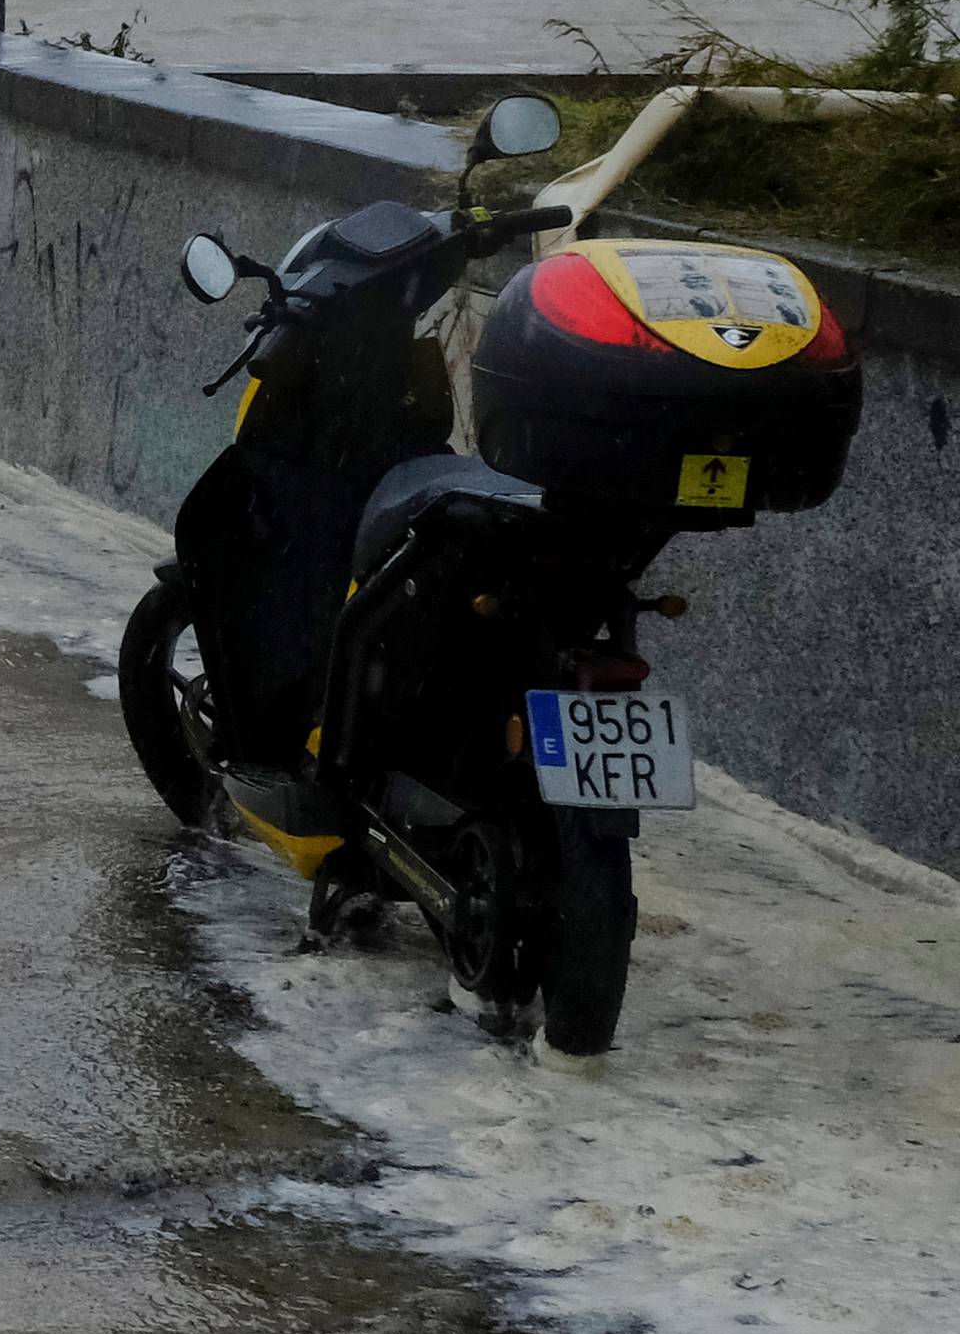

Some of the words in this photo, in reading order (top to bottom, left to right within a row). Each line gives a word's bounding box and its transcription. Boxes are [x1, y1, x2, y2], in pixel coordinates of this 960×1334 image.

[568, 699, 676, 745] 9561
[543, 738, 558, 754] E
[574, 753, 657, 799] KFR
